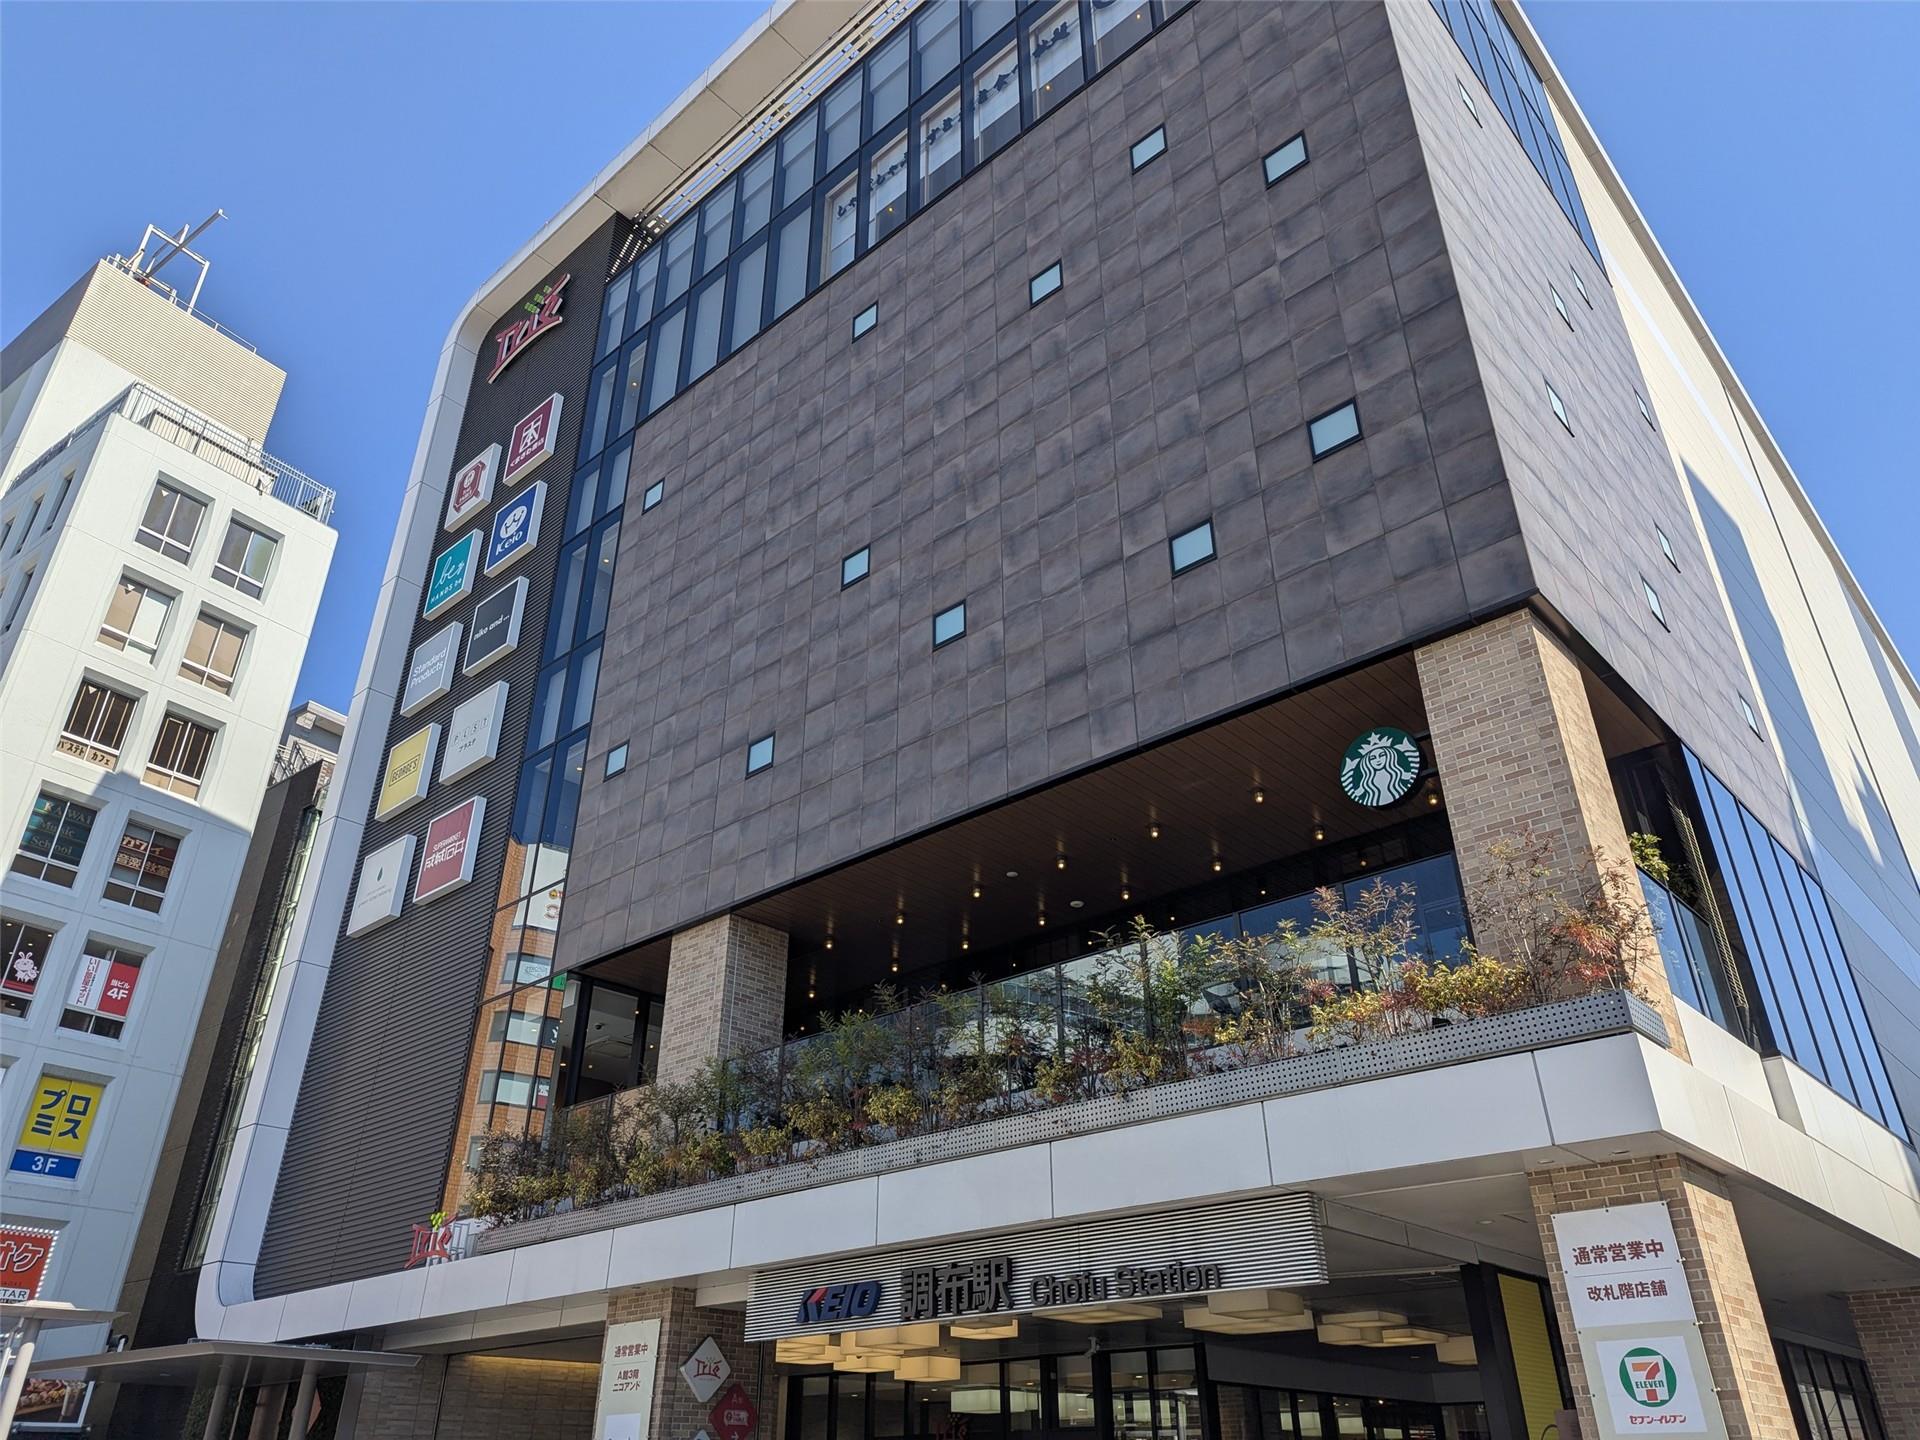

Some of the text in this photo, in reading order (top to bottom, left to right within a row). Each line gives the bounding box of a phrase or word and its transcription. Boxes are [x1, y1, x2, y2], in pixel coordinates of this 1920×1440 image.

[413, 648, 446, 677] Standard
[410, 661, 443, 688] Products
[91, 751, 110, 766] カフェ
[43, 801, 92, 825] KAWAI
[122, 835, 164, 856] カワイ
[107, 988, 128, 1000] 4F
[31, 1156, 59, 1173] 3F
[1572, 1239, 1665, 1266] 通常営業中
[0, 1289, 28, 1299] TAR
[796, 1280, 882, 1323] KEIO
[900, 1256, 1014, 1320] 調布駅
[1114, 1261, 1221, 1298] Station
[1587, 1280, 1668, 1302] 改札階店舗
[614, 1342, 648, 1358] 通常営業中
[612, 1381, 641, 1392] ニコアンド
